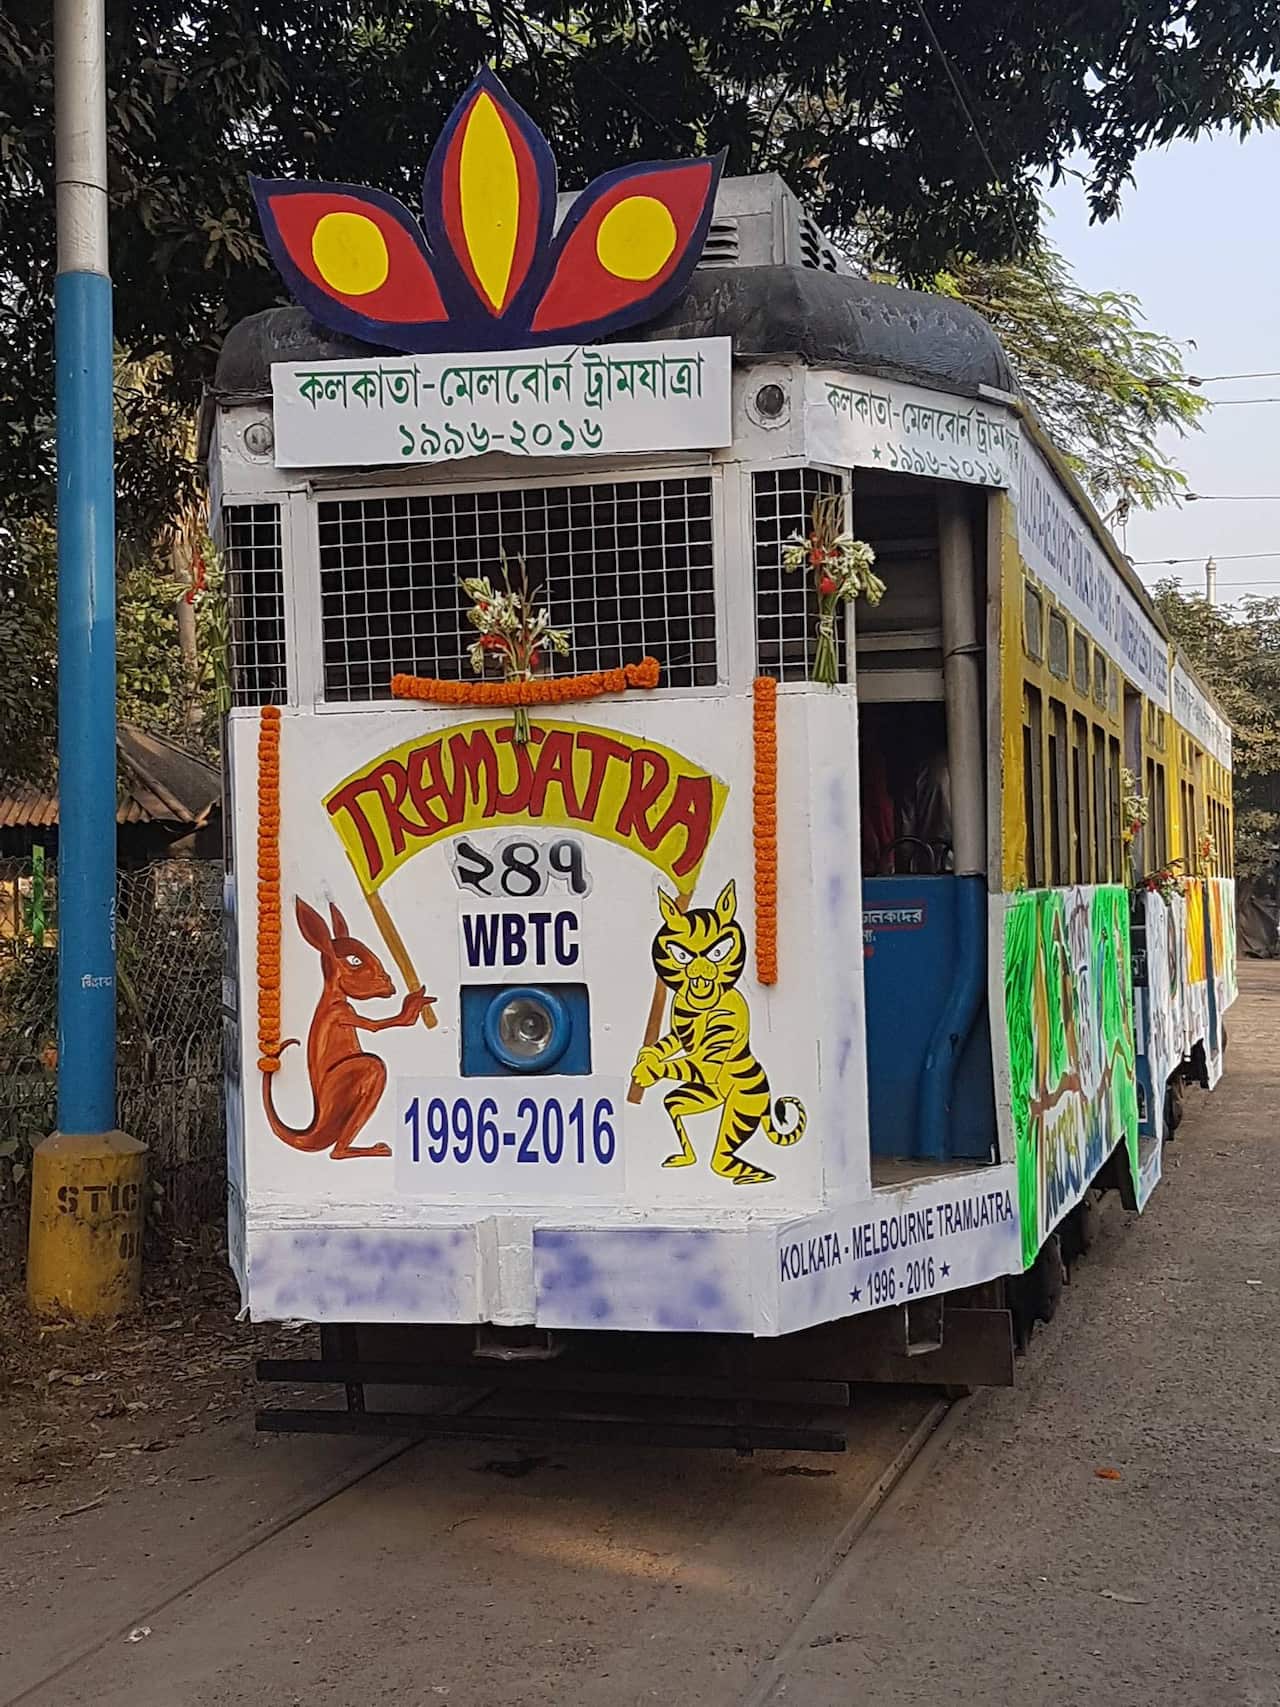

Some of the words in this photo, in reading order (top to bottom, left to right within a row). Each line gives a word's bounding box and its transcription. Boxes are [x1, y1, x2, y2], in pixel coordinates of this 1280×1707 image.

[294, 347, 579, 410] কলকাতা-মেলবোর্ন
[582, 347, 705, 410] ট্রামযাত্রা
[399, 418, 603, 455] ১৯৯৬-২০১৬
[824, 381, 976, 447] কলকাতা-মেলবোর্ন
[886, 441, 1003, 484] ১৯৯৬-২০১৬
[327, 726, 714, 880] TRAMJATRA
[455, 840, 587, 896] ২৪৭
[462, 911, 579, 967] WBTC
[404, 1097, 616, 1166] 1996-2016
[780, 1232, 841, 1282] KOLKATA
[852, 1208, 934, 1261] MELBOURNE
[936, 1190, 1013, 1236] TRAMJATRA
[867, 1267, 895, 1305] 1996
[907, 1256, 935, 1295] 2016
